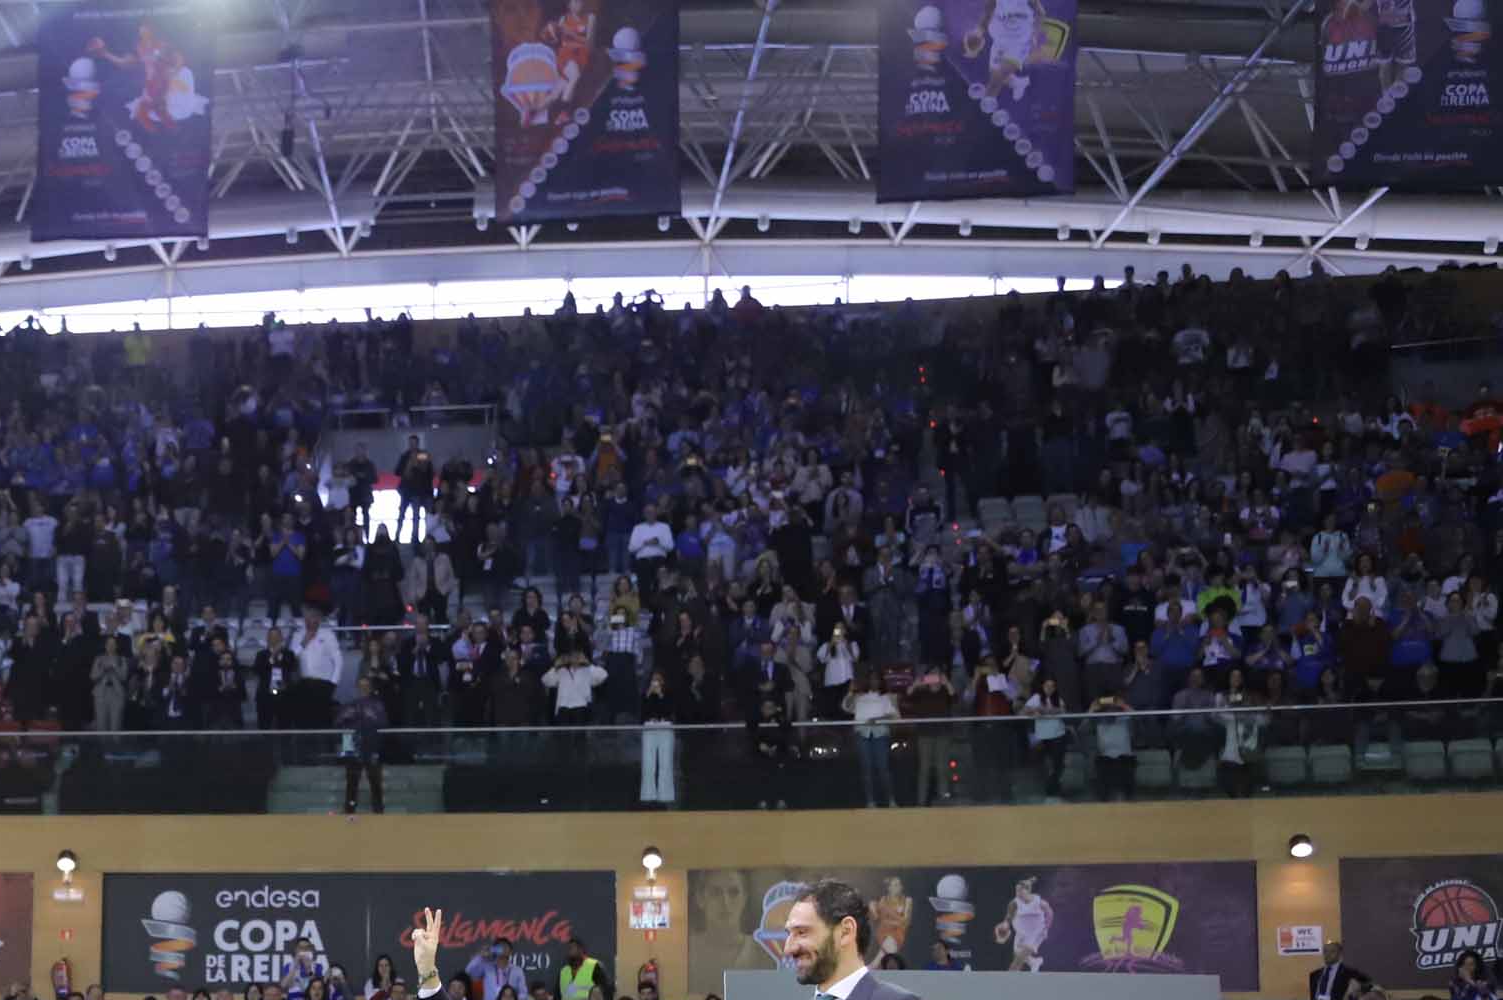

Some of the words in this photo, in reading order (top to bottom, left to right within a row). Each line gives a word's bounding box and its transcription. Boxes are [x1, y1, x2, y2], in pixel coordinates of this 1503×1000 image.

[215, 885, 320, 908] endesa
[213, 919, 325, 952] COPA
[1419, 922, 1499, 953] UNI
[205, 954, 226, 968] DE
[205, 968, 226, 982] LA
